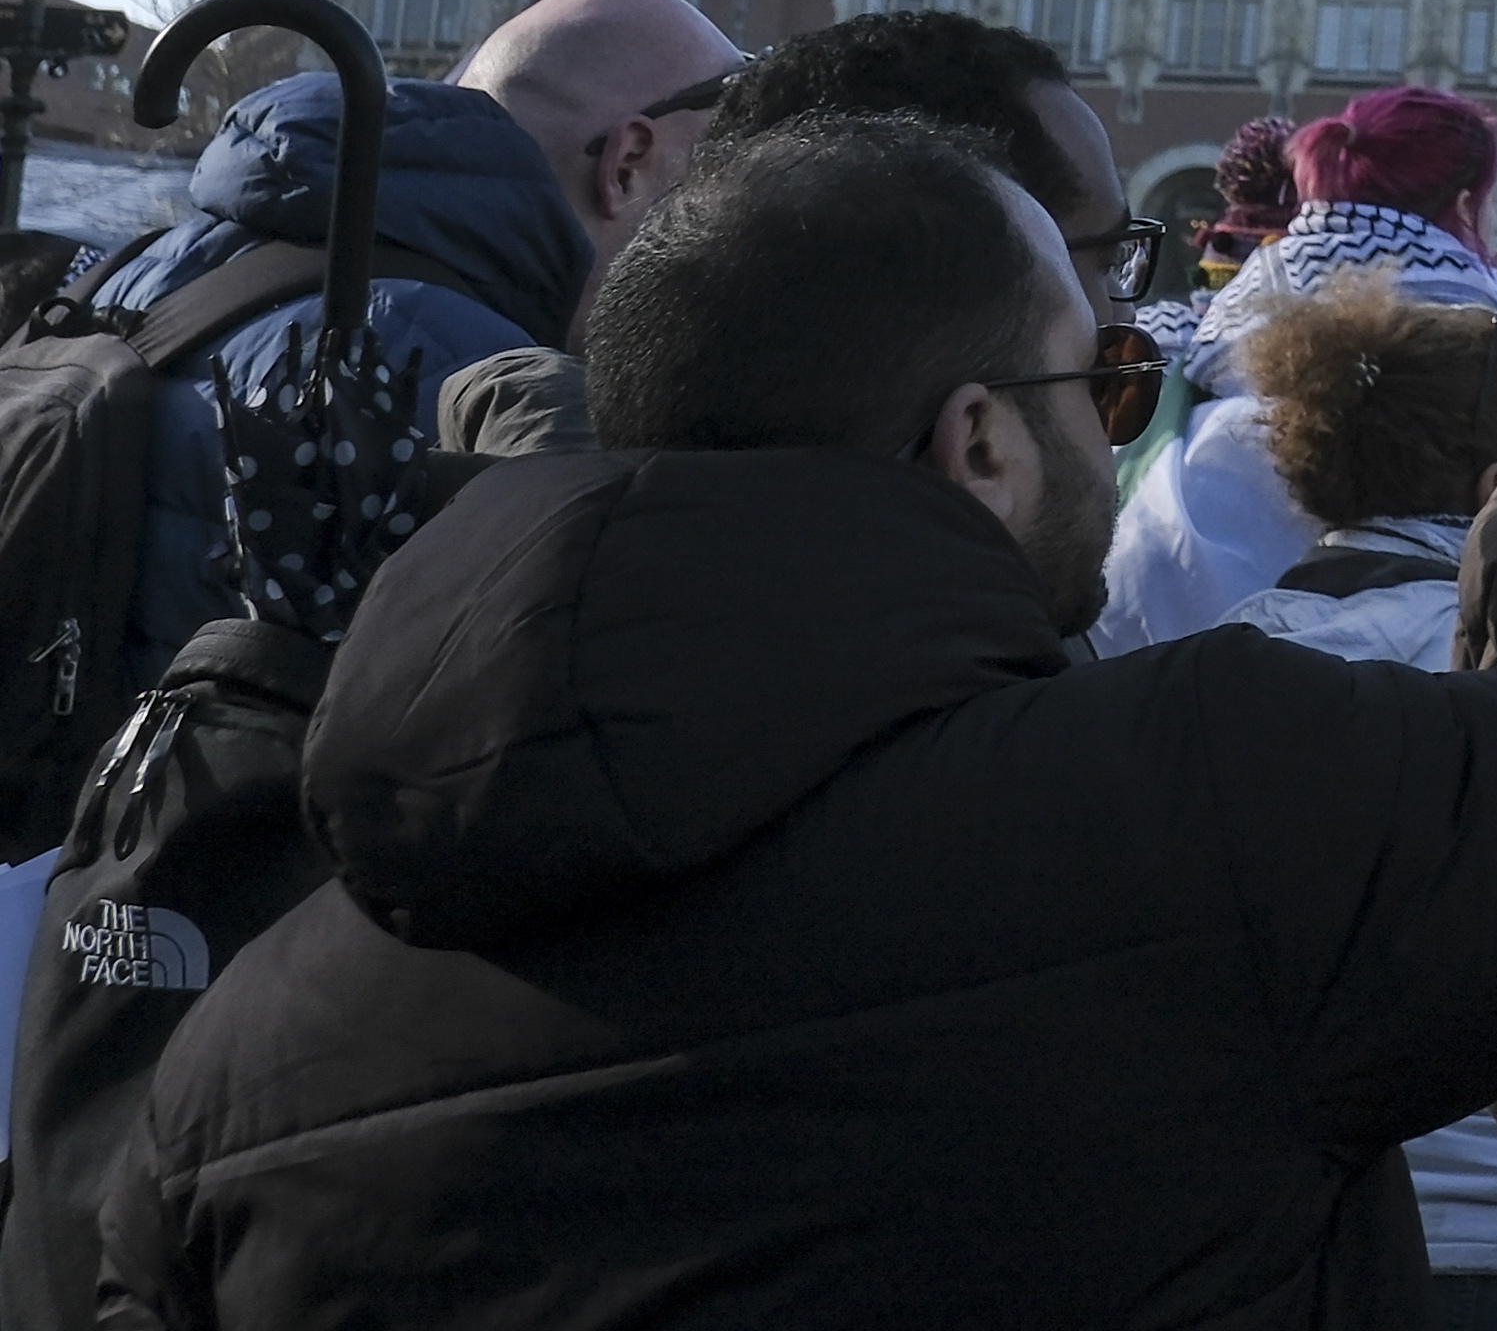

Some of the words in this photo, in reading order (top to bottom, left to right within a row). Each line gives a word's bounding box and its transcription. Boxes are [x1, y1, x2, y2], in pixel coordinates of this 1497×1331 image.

[99, 898, 147, 931] THE
[62, 921, 150, 959] NORTH
[79, 954, 150, 987] FACE
